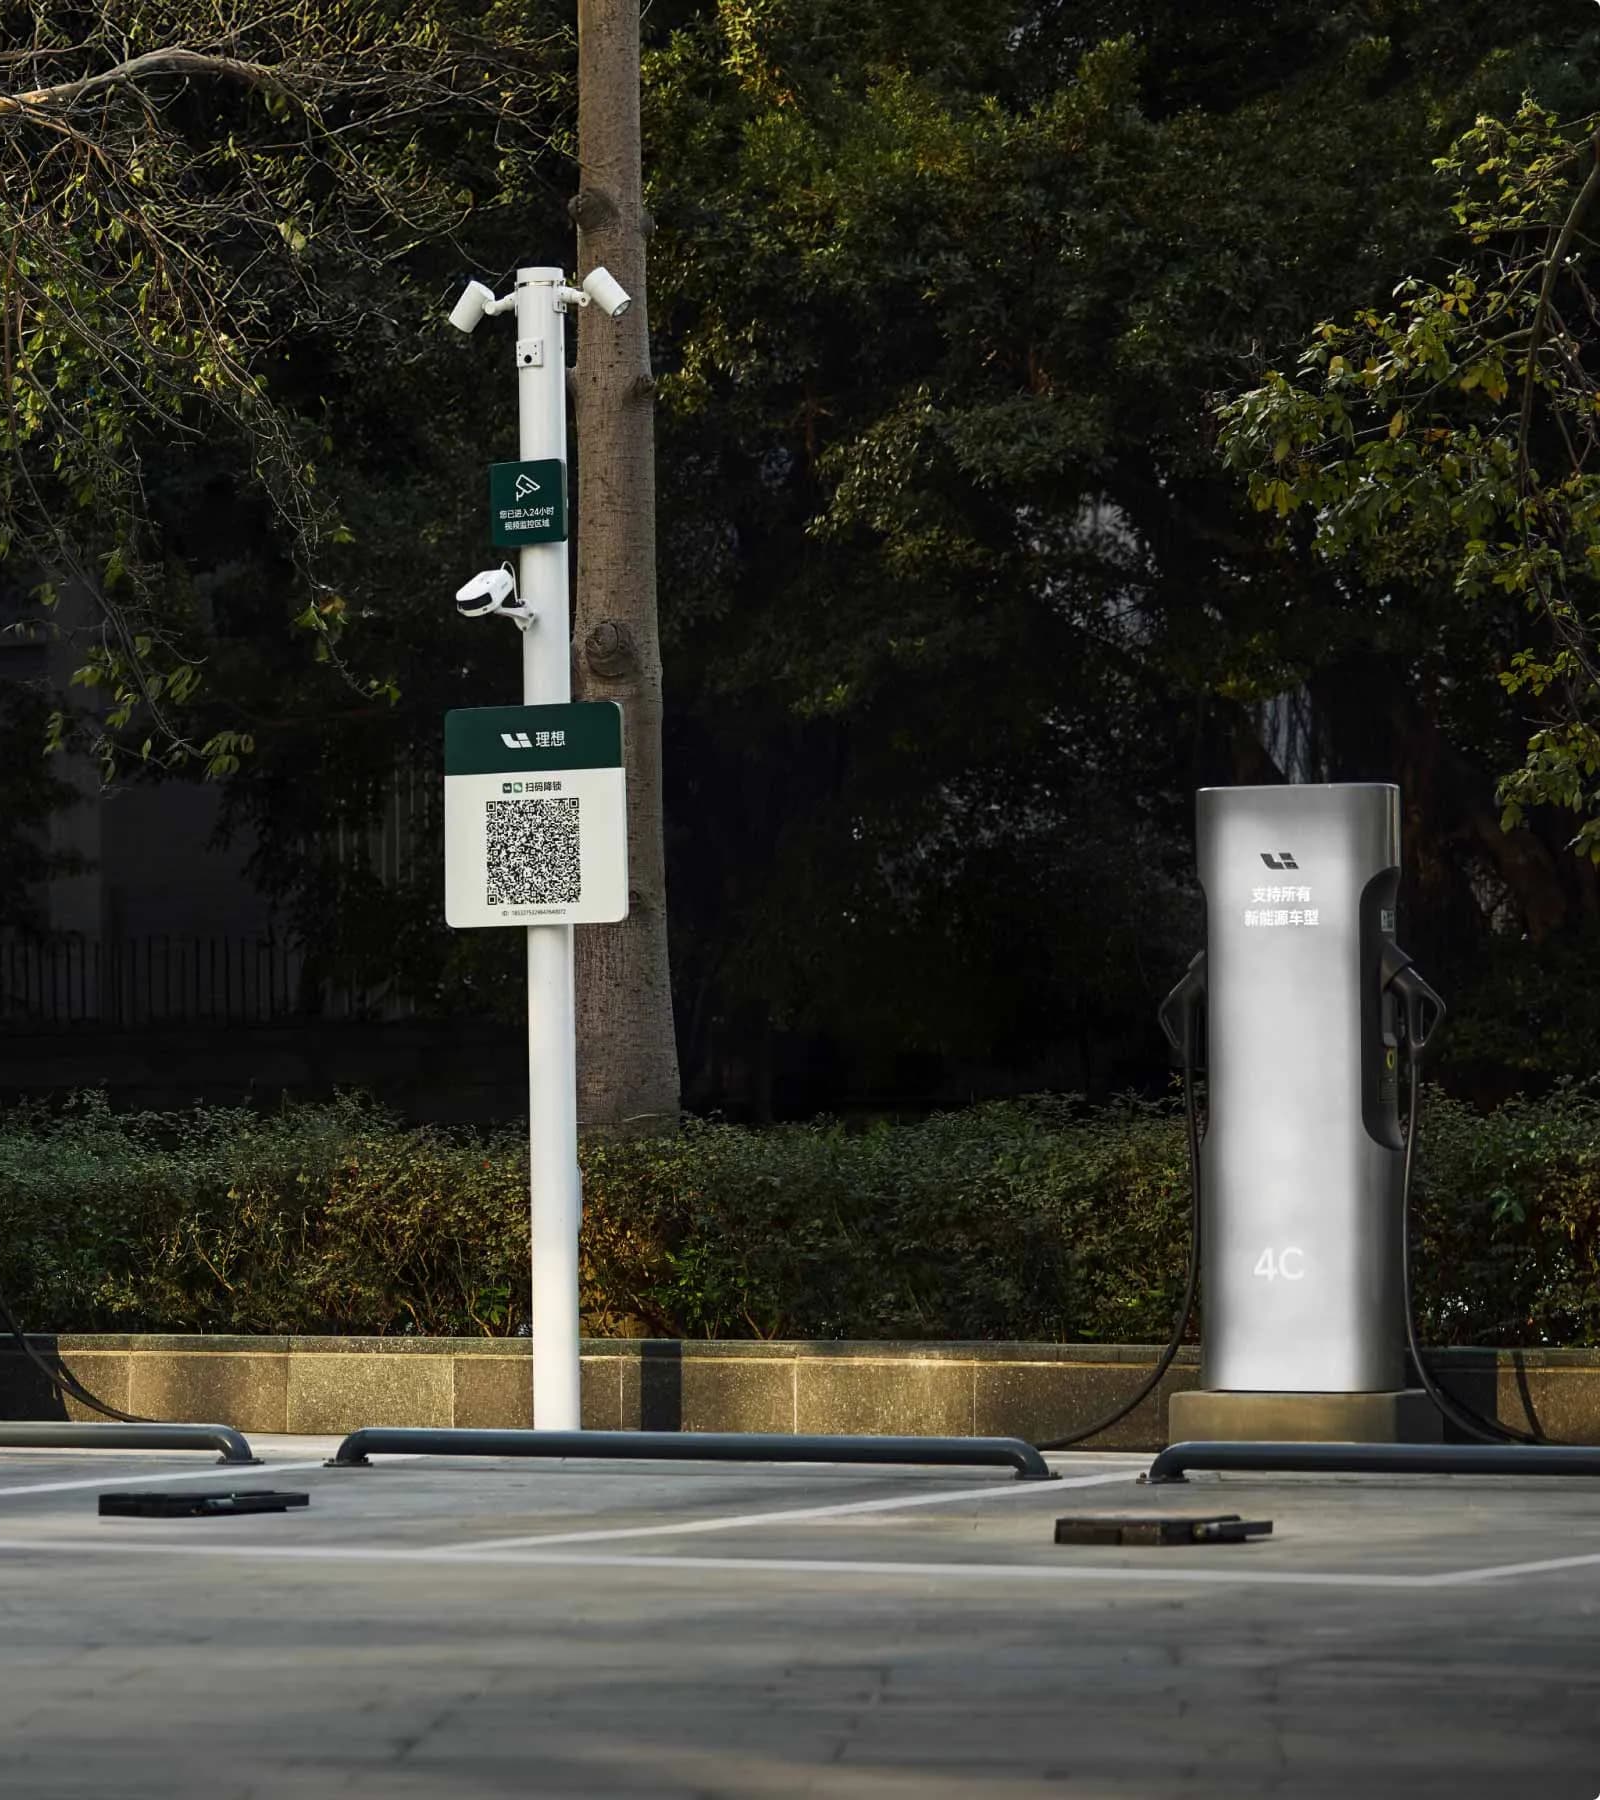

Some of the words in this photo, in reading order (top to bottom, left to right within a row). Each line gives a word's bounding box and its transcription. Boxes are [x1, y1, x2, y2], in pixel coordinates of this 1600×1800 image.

[535, 730, 566, 748] 理想
[525, 781, 562, 792] 扫码降锁
[1251, 885, 1312, 904] 支持所有
[1244, 908, 1320, 927] 新能源车型
[1253, 1246, 1305, 1281] 4C
